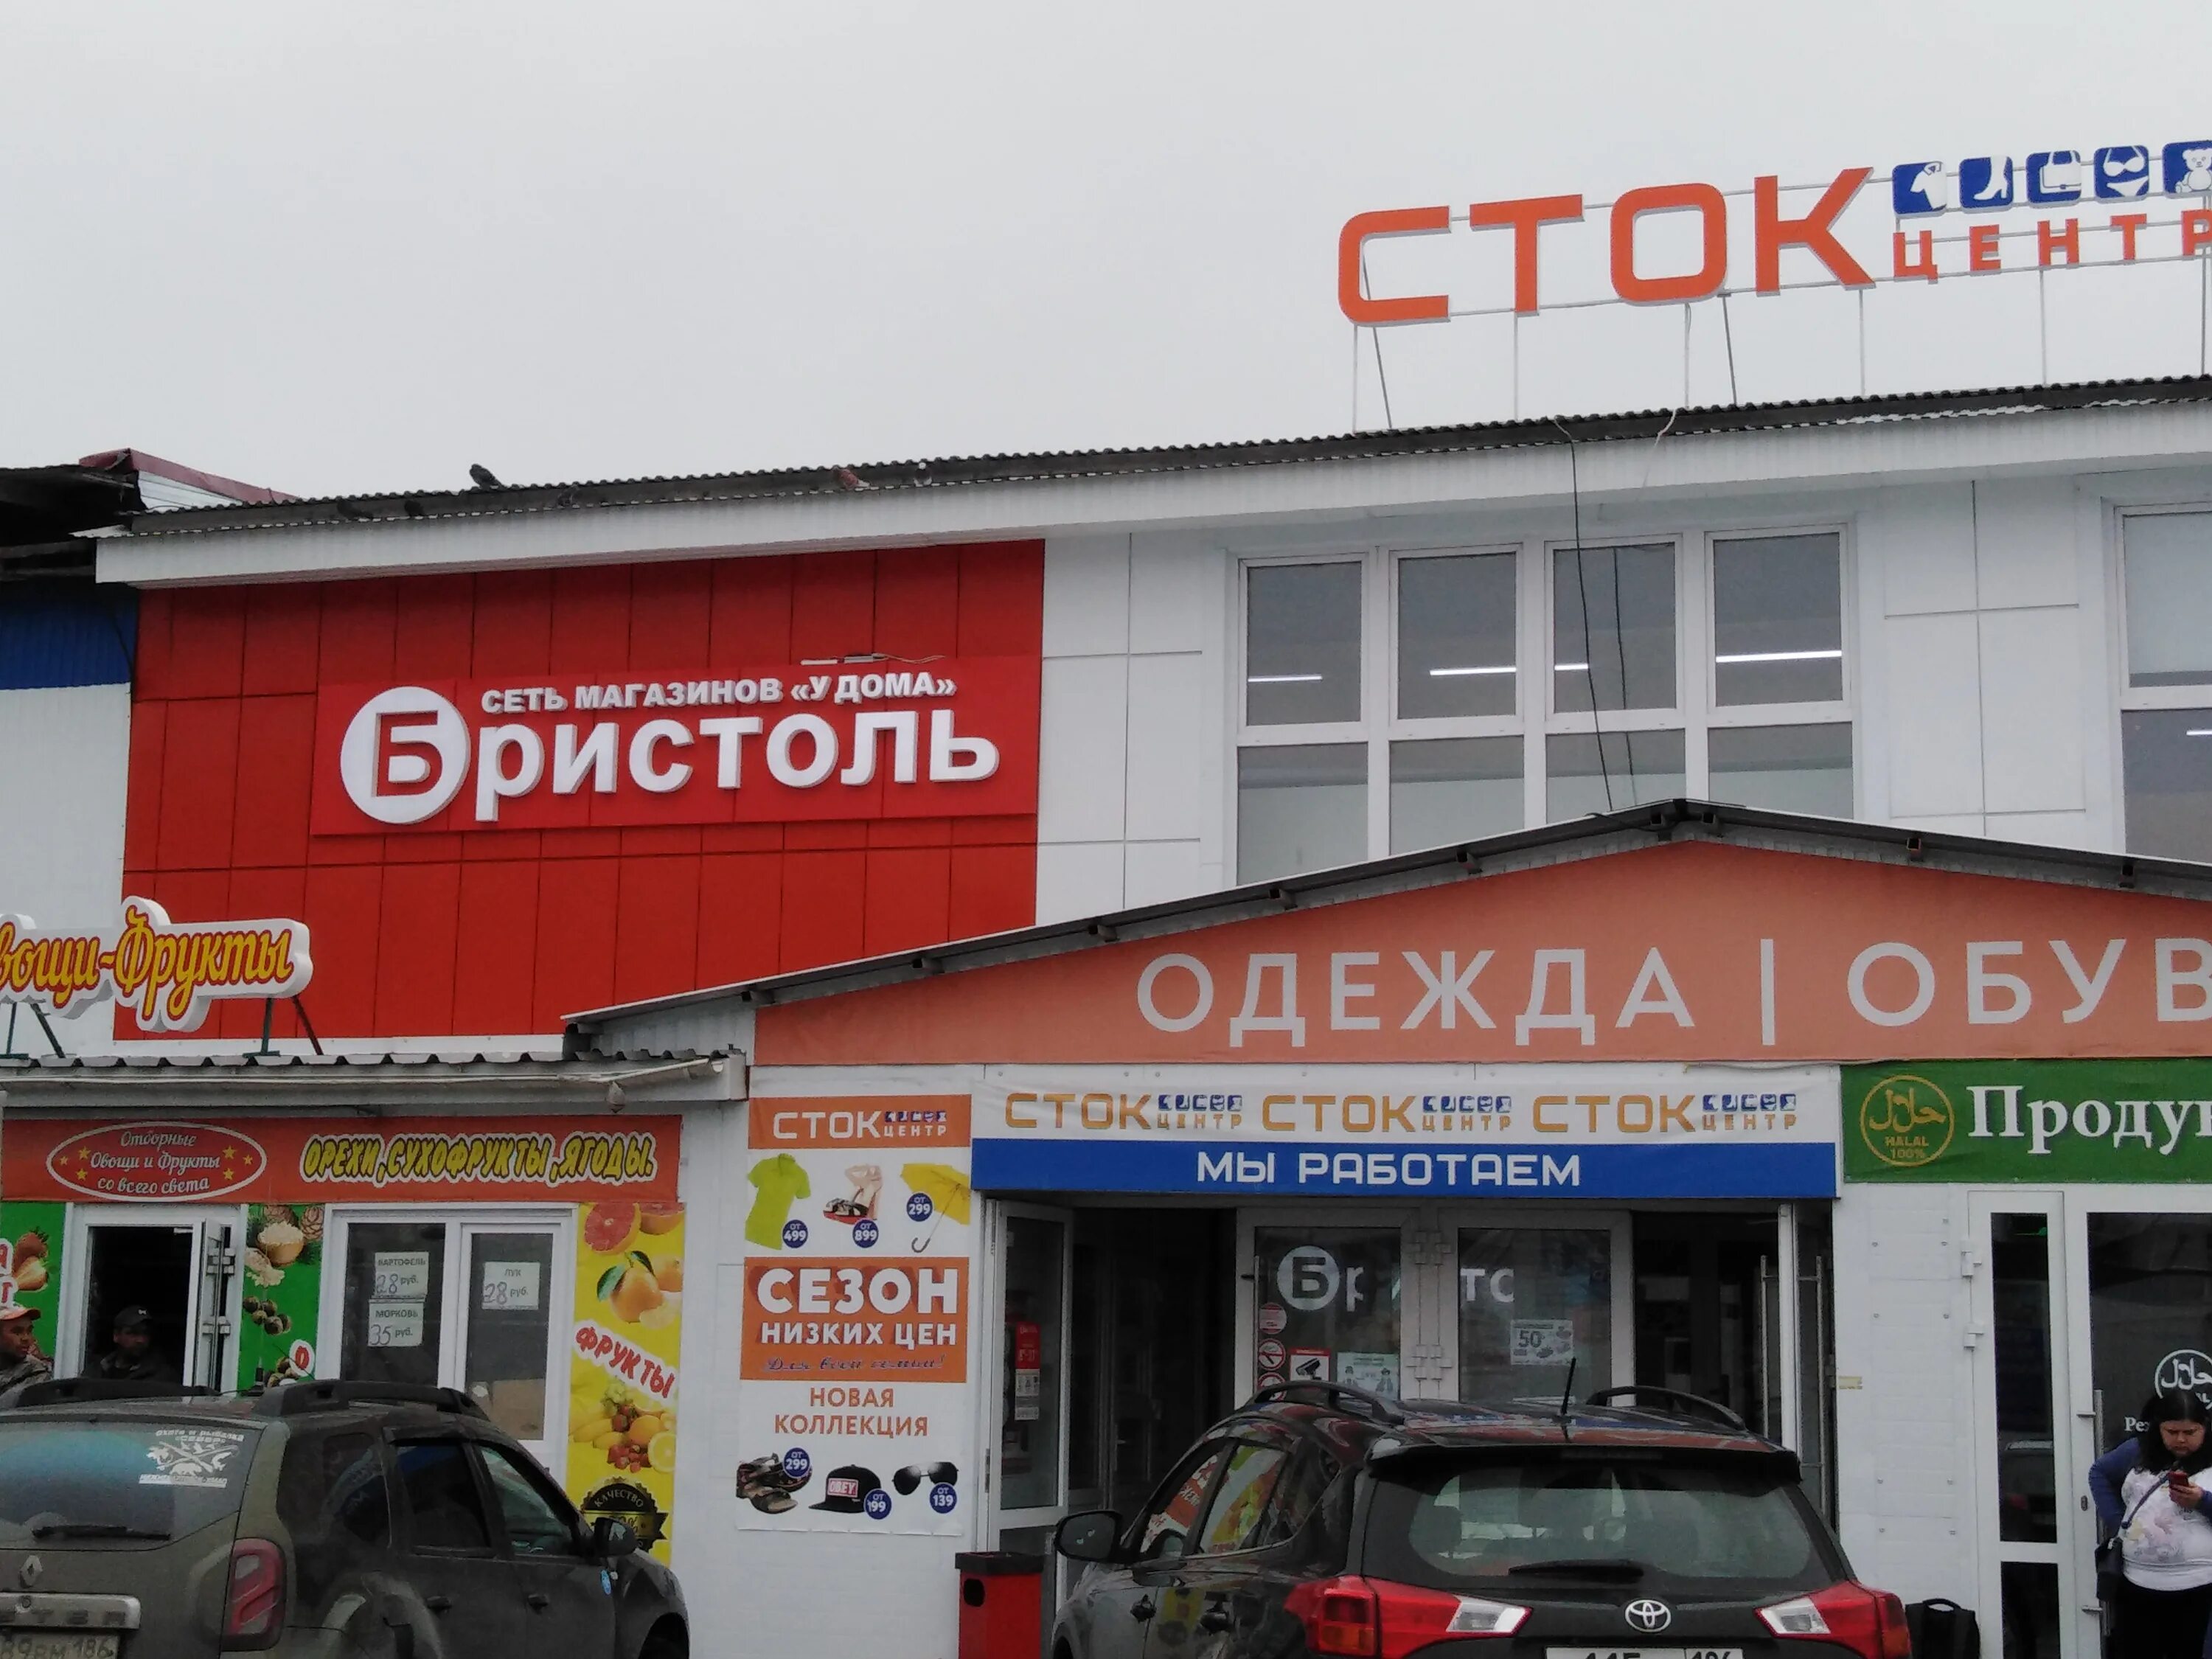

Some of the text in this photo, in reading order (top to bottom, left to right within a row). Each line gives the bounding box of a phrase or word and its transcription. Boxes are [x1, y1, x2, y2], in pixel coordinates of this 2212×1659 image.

[1338, 167, 2212, 327] СТОК ЦЕНТР
[481, 686, 566, 714] СЕТЬ
[574, 678, 783, 711] МАГАЗИНОВ
[834, 671, 956, 705] ДОМА»
[1847, 938, 2212, 1027] ОБУВ
[1137, 947, 1695, 1048] ОДЕЖДА
[773, 1110, 947, 1139] СТОК ЦЕНТР
[1005, 1093, 1797, 1133] СТОК ЦЕНТР СТОК ЦЕНТР СТОК ЦЕНТР
[120, 1130, 198, 1152] Отборные
[1885, 1136, 1930, 1147] HALAL
[90, 1150, 221, 1176] Овощи и Фрукты
[1197, 1151, 1580, 1186] МЫ РАБОТАЕМ
[97, 1177, 210, 1195] со всего света
[908, 1203, 931, 1216] 299
[783, 1229, 806, 1242] 499
[855, 1229, 877, 1242] 899
[376, 1273, 399, 1294] 28
[484, 1281, 508, 1304] 28
[757, 1267, 959, 1315] СЕЗОН
[761, 1322, 957, 1350] НИЗКИХ ЦЕН
[575, 1326, 675, 1399] ФРУКТЫ
[810, 1388, 894, 1408] НОВАЯ
[774, 1414, 928, 1439] КОЛЛЕКЦИЯ
[785, 1458, 808, 1470] 299
[594, 1489, 644, 1508] КАЧЕСТВО
[866, 1500, 886, 1513] 199
[932, 1494, 954, 1507] 139
